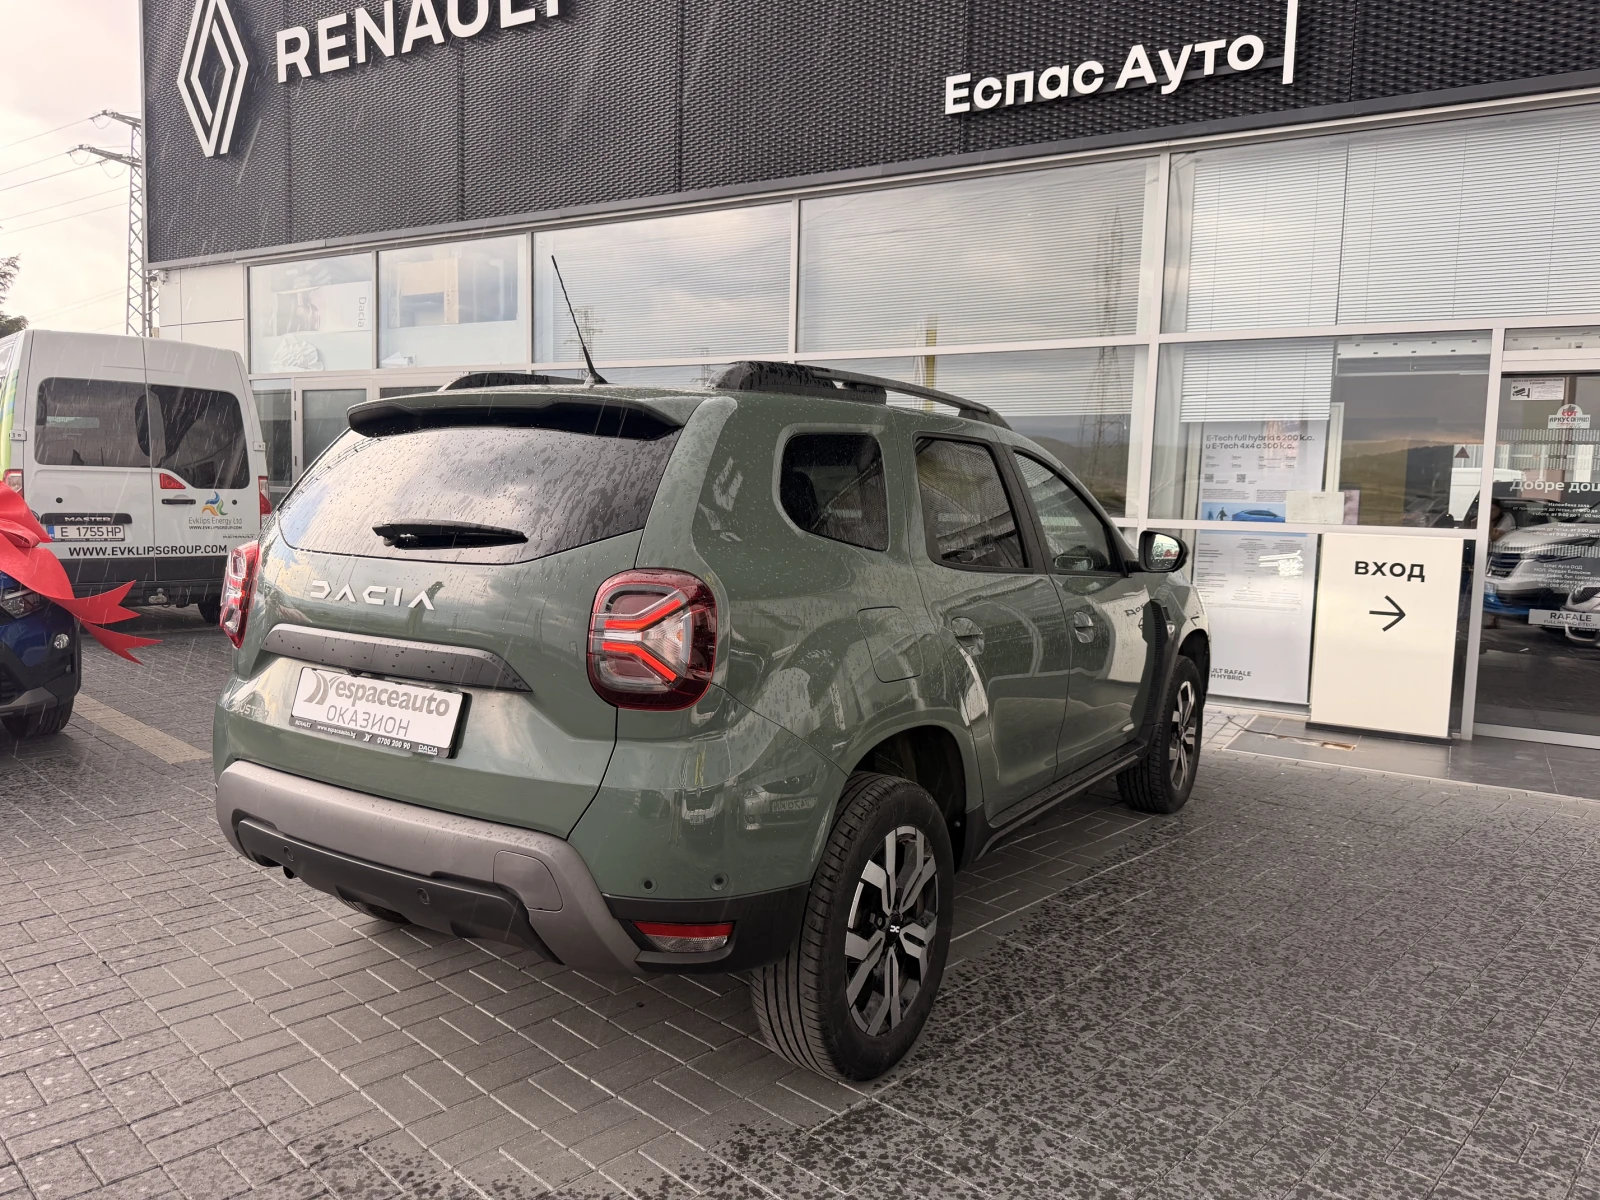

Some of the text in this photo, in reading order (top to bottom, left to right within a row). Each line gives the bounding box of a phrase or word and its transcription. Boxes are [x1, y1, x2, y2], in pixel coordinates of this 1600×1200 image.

[944, 33, 1265, 115] Еспас Ауто
[357, 296, 367, 328] Dacia
[1206, 434, 1233, 442] E-Tech
[1248, 434, 1275, 443] hybrid
[1509, 478, 1565, 493] Добре
[188, 516, 243, 526] Evklips Energy Ltd
[60, 526, 69, 538] E
[76, 526, 105, 538] 1755
[106, 526, 122, 538] HP
[68, 544, 228, 557] WWW.EVKLIPSGROUP.COM
[1354, 560, 1426, 583] ВХОД
[309, 579, 435, 611] DACIA
[1550, 612, 1592, 622] RAFALE
[1223, 668, 1251, 676] RAFALE
[335, 680, 450, 717] espaceauto
[326, 704, 410, 738] ОКАЗИОН
[377, 736, 391, 746] 0700
[391, 739, 403, 748] 200
[403, 742, 411, 750] 90
